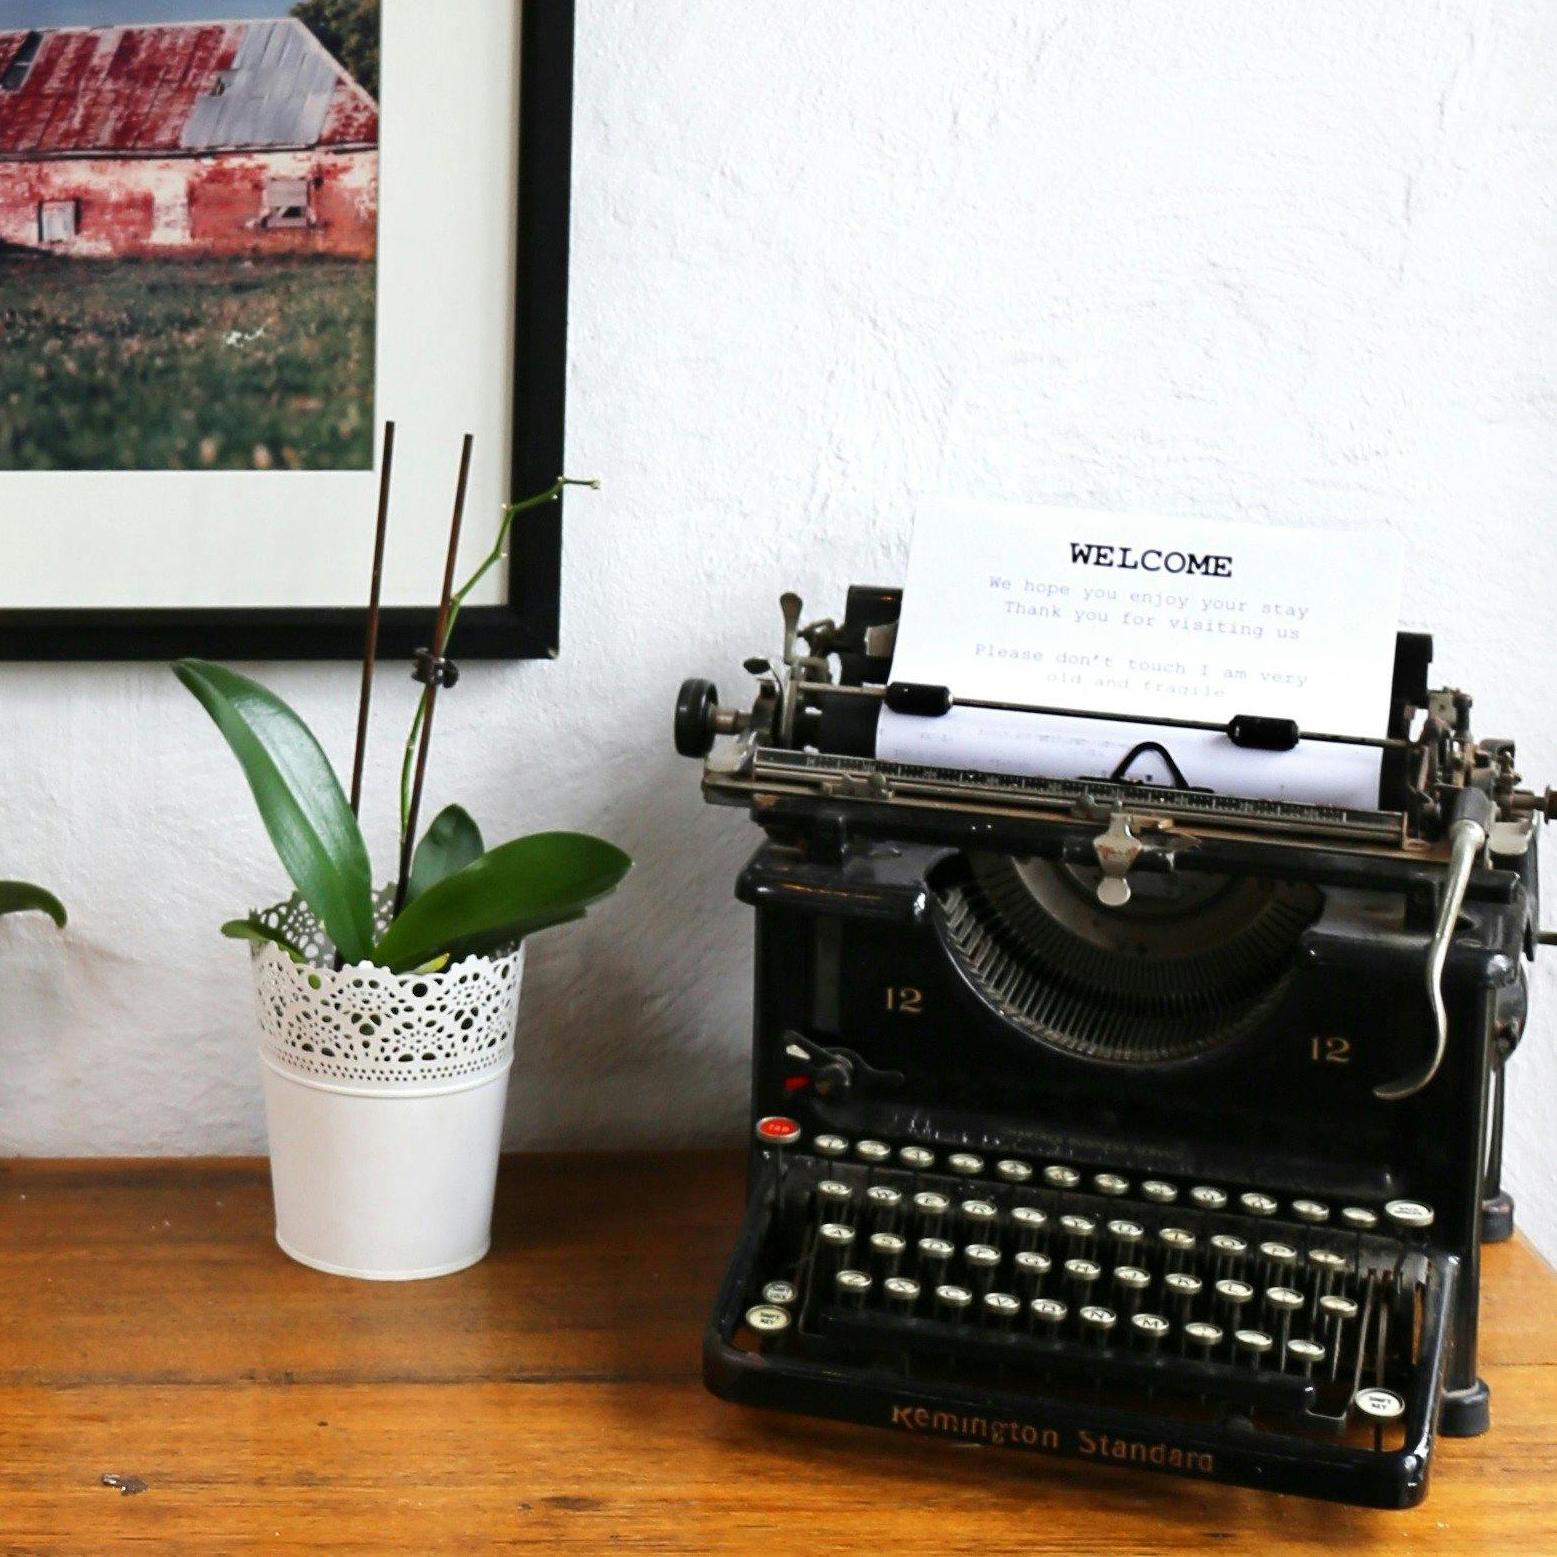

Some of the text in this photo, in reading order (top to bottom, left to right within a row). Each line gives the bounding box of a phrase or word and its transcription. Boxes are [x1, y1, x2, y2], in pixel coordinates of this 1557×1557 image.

[1069, 542, 1233, 578] WELCOME
[989, 576, 1309, 620] We hope you enjoy your stay
[1004, 600, 1300, 640] Thank you for visiting us
[974, 643, 1308, 688] Please don't touch I am very
[1046, 672, 1226, 698] old and fragile
[885, 986, 924, 1014] 12
[1310, 1036, 1351, 1063] 12
